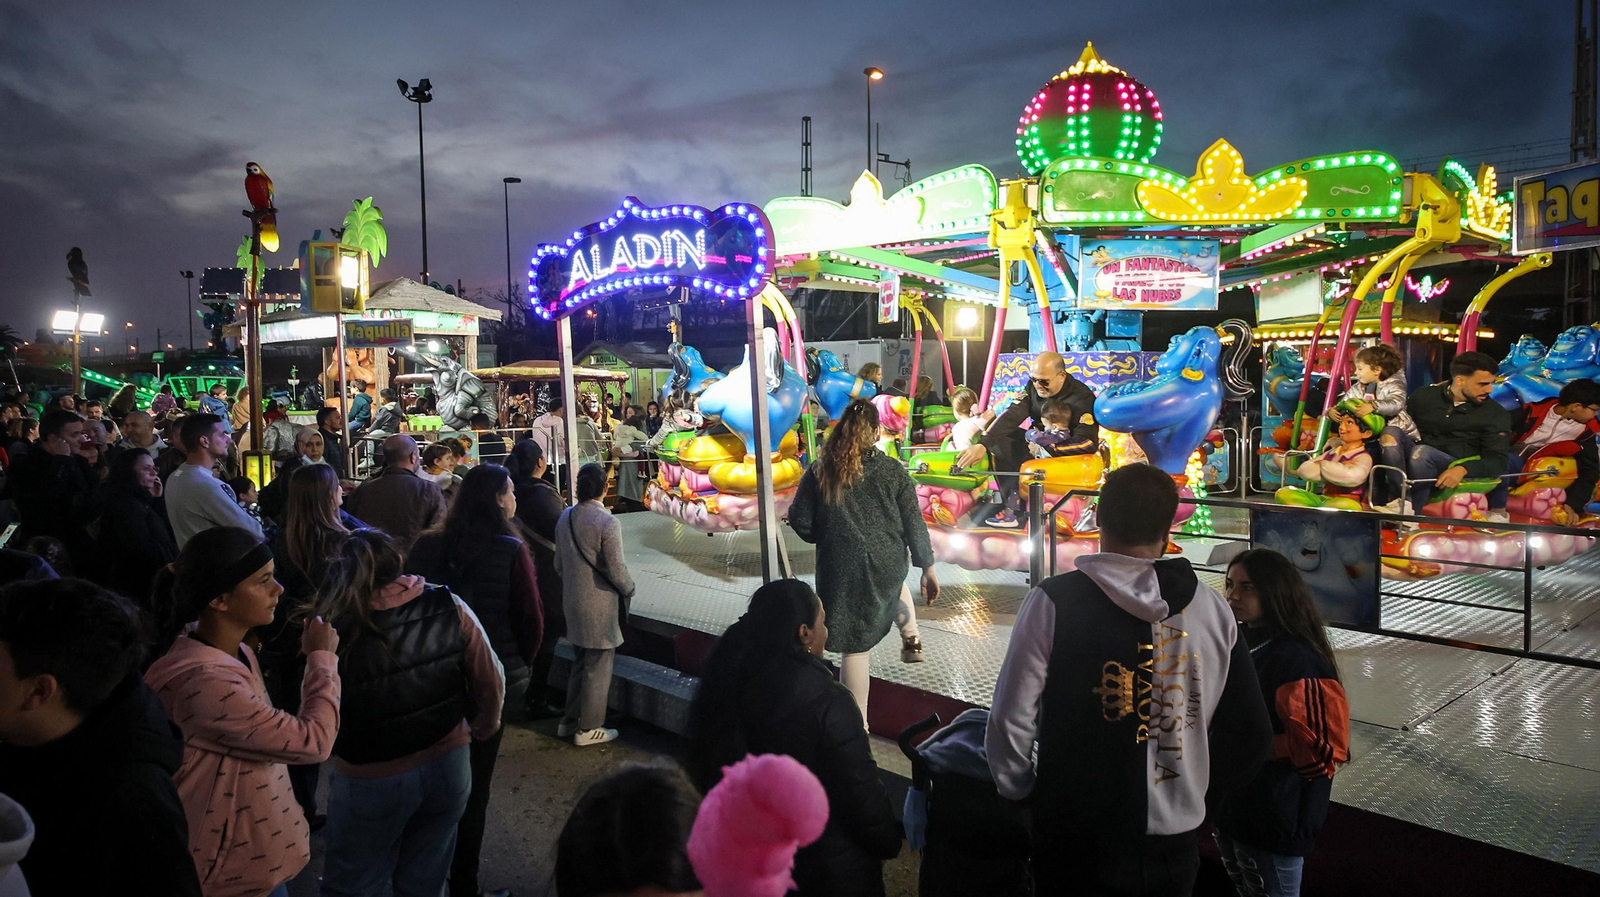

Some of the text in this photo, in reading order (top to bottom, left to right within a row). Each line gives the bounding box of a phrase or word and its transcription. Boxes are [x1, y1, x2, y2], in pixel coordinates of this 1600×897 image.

[567, 229, 706, 291] ALADIN
[1102, 261, 1120, 275] UN
[1112, 287, 1182, 303] LAS NUBES
[347, 322, 411, 342] Taquilla
[1136, 631, 1165, 745] ROYAL
[1154, 609, 1190, 786] ANGSTA
[1184, 691, 1202, 730] MMX
